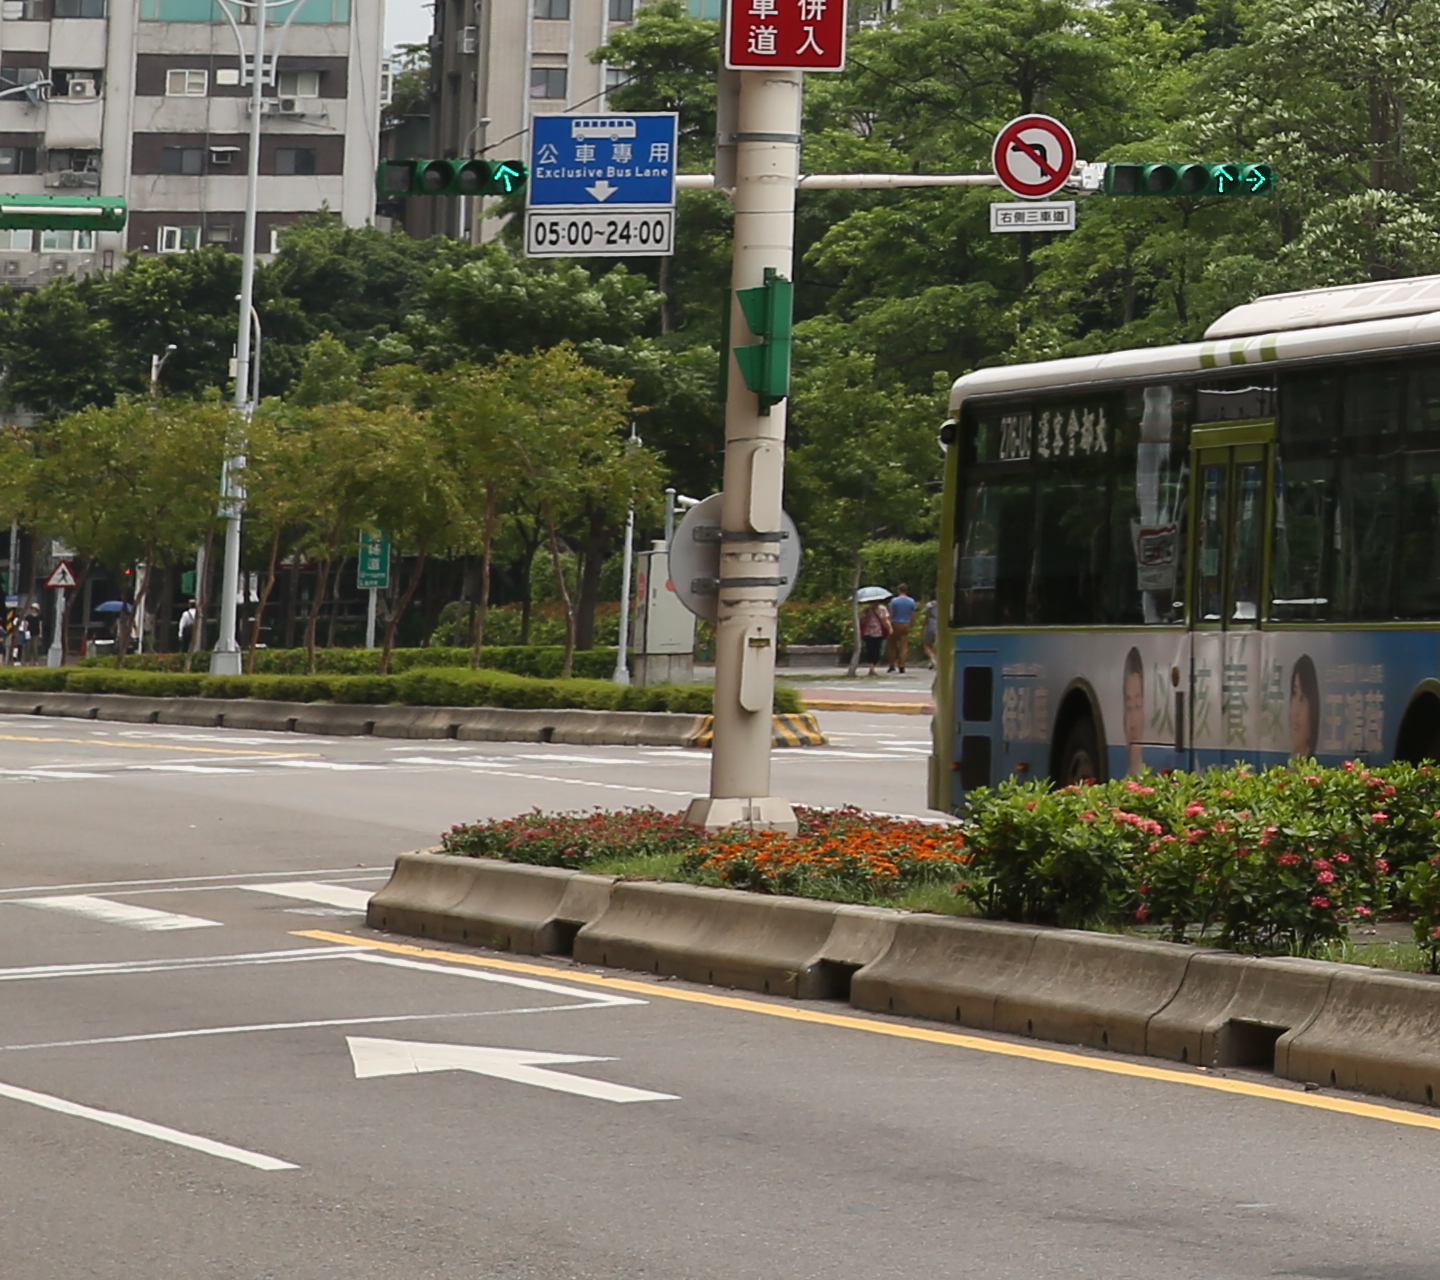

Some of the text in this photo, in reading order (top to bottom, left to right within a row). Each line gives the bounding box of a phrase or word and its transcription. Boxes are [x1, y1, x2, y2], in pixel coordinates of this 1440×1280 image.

[537, 142, 669, 165] 公車專用
[536, 166, 668, 179] Exclusive Bus Lane
[1000, 210, 1065, 224] 右側三車道
[534, 220, 665, 246] 05:00~24:00
